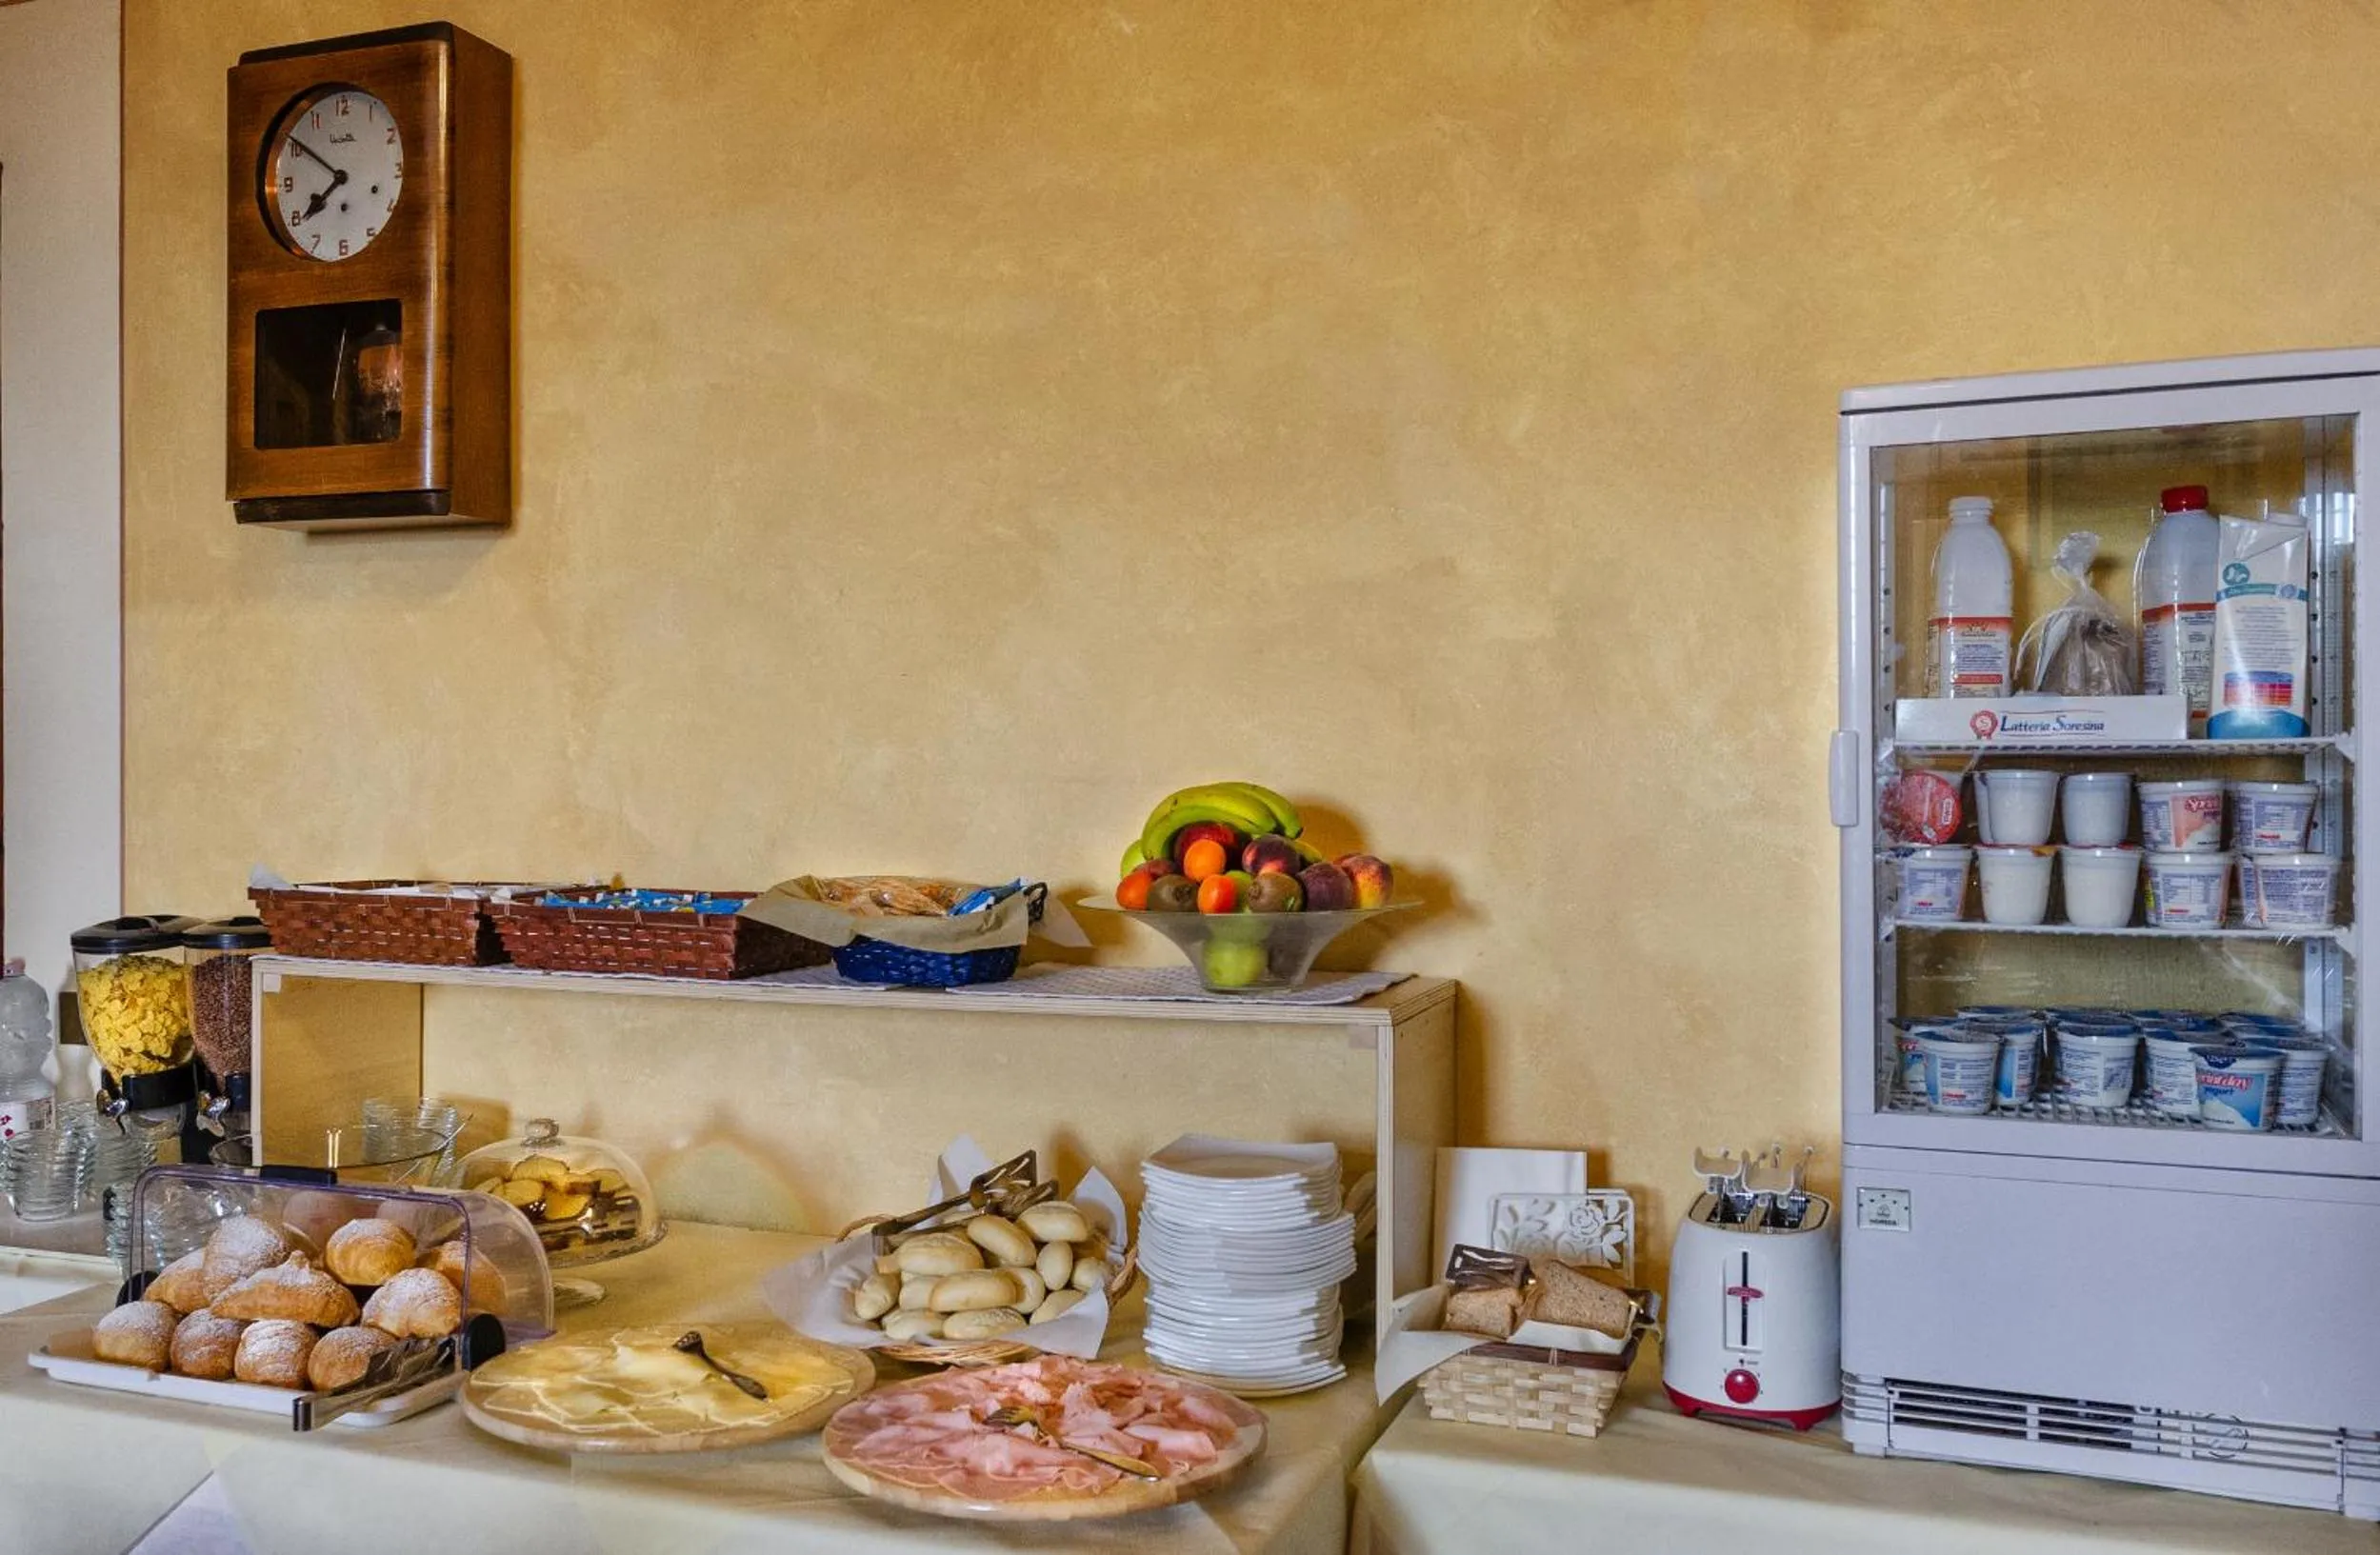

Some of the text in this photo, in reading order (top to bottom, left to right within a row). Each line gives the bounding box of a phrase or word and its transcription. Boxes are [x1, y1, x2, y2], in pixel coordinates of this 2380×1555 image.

[335, 98, 350, 116] 12
[310, 110, 321, 130] 11
[386, 127, 396, 145] 2
[283, 177, 293, 192] 9
[290, 209, 302, 227] 8
[310, 234, 321, 254] 7
[338, 239, 349, 256] 6
[2000, 714, 2105, 732] Latteria Soresina
